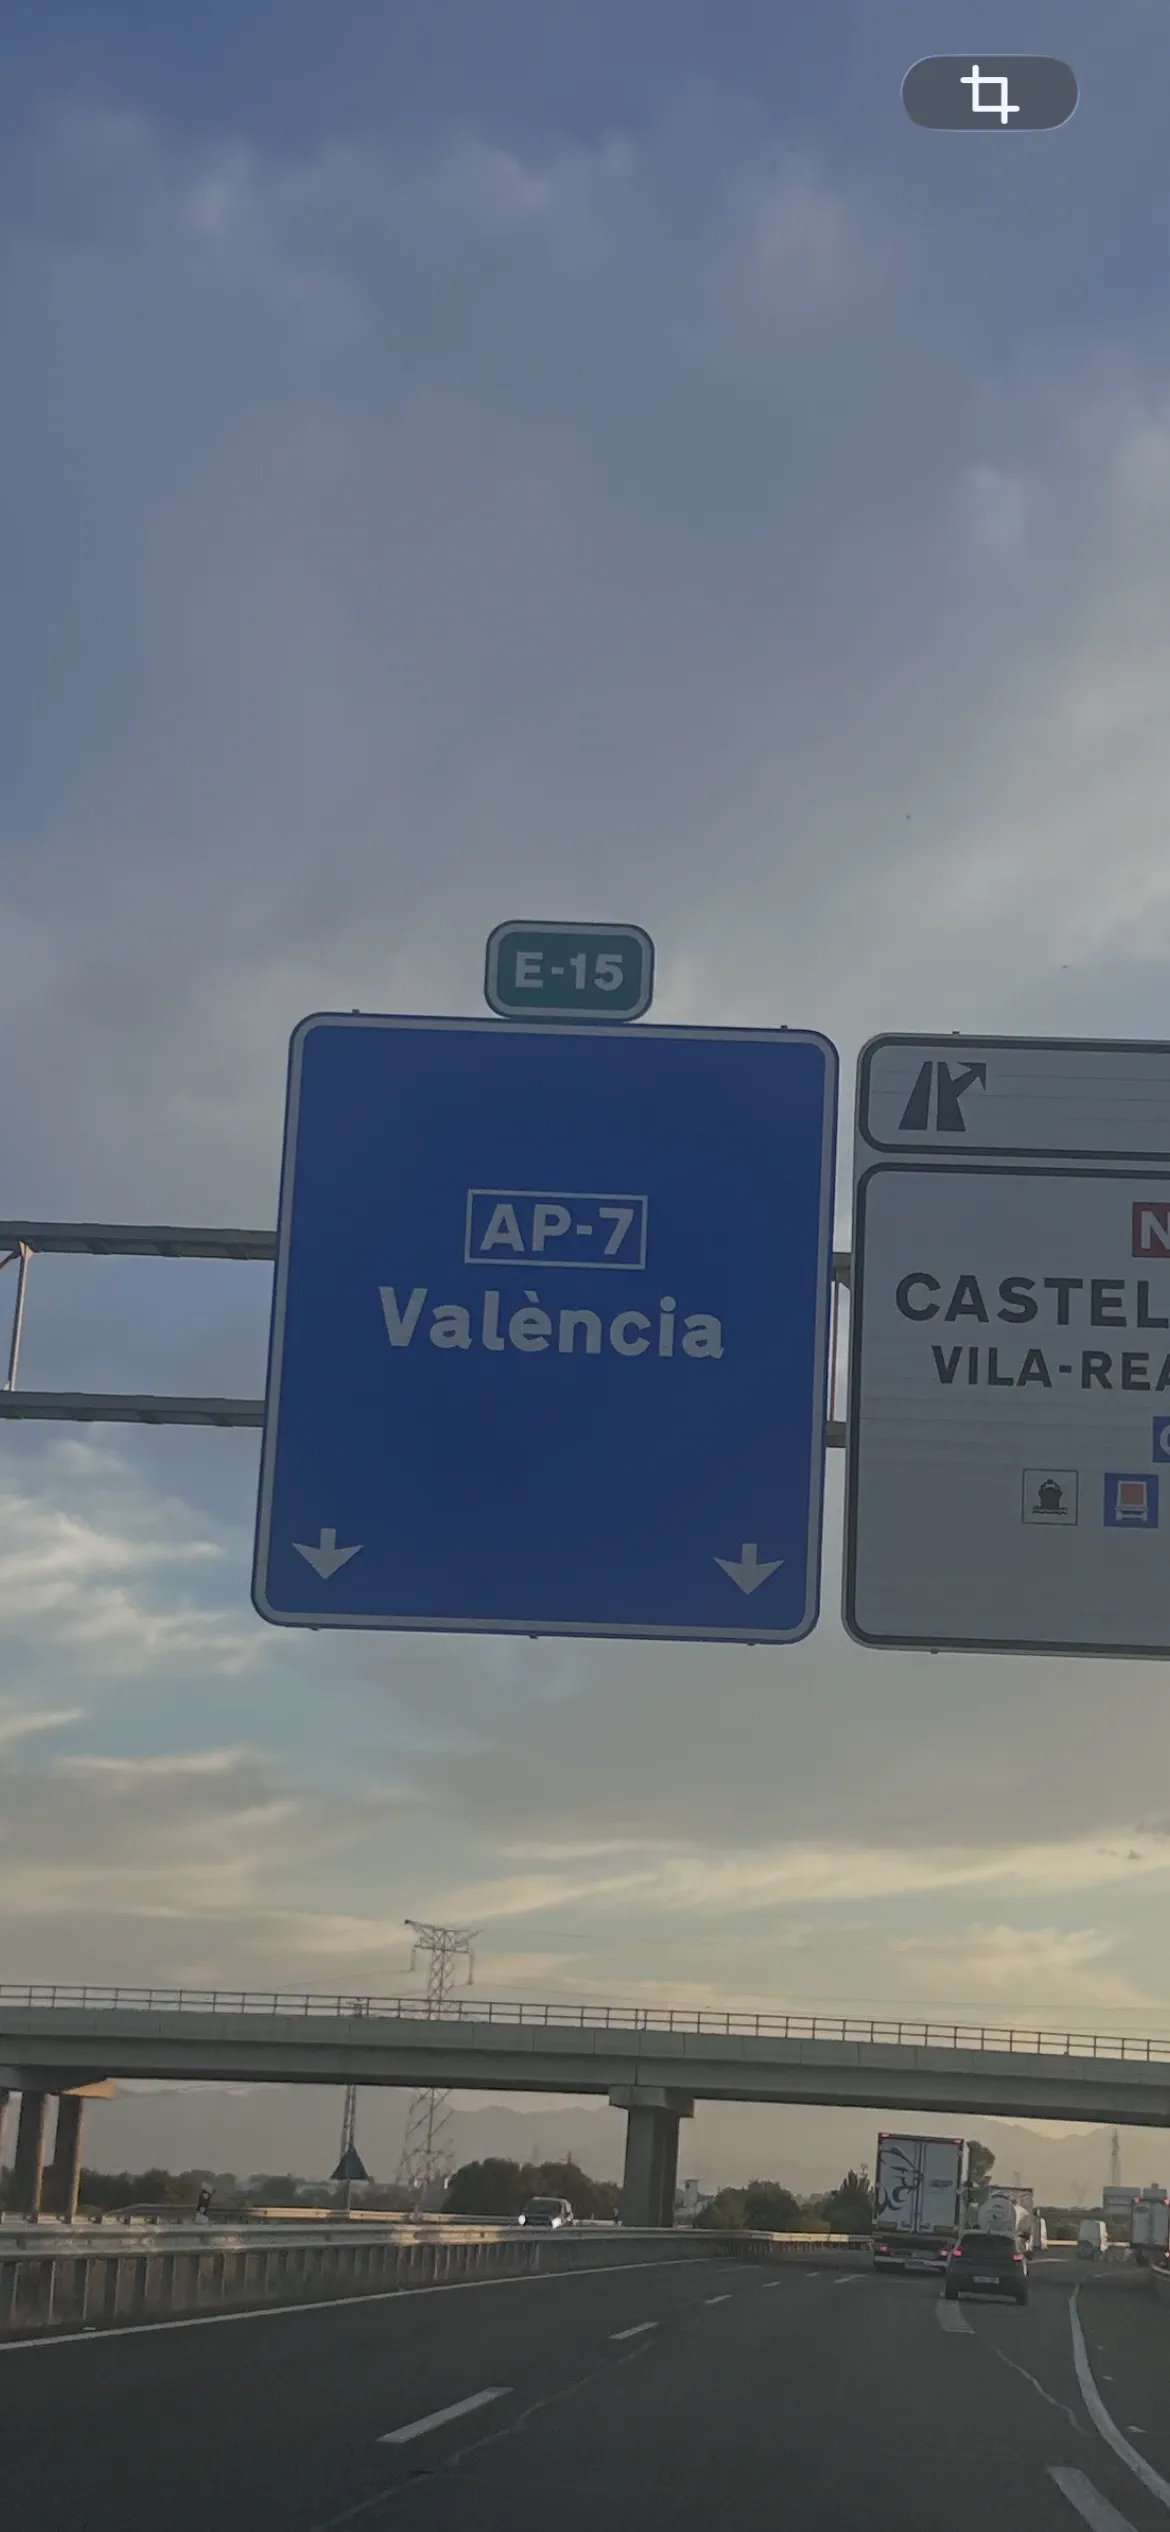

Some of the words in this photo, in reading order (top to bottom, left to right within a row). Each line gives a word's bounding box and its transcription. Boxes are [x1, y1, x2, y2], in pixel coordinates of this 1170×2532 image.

[514, 951, 624, 992] E-15
[480, 1203, 634, 1256] AP-7
[378, 1285, 725, 1360] València
[895, 1272, 1170, 1329] CASTEL
